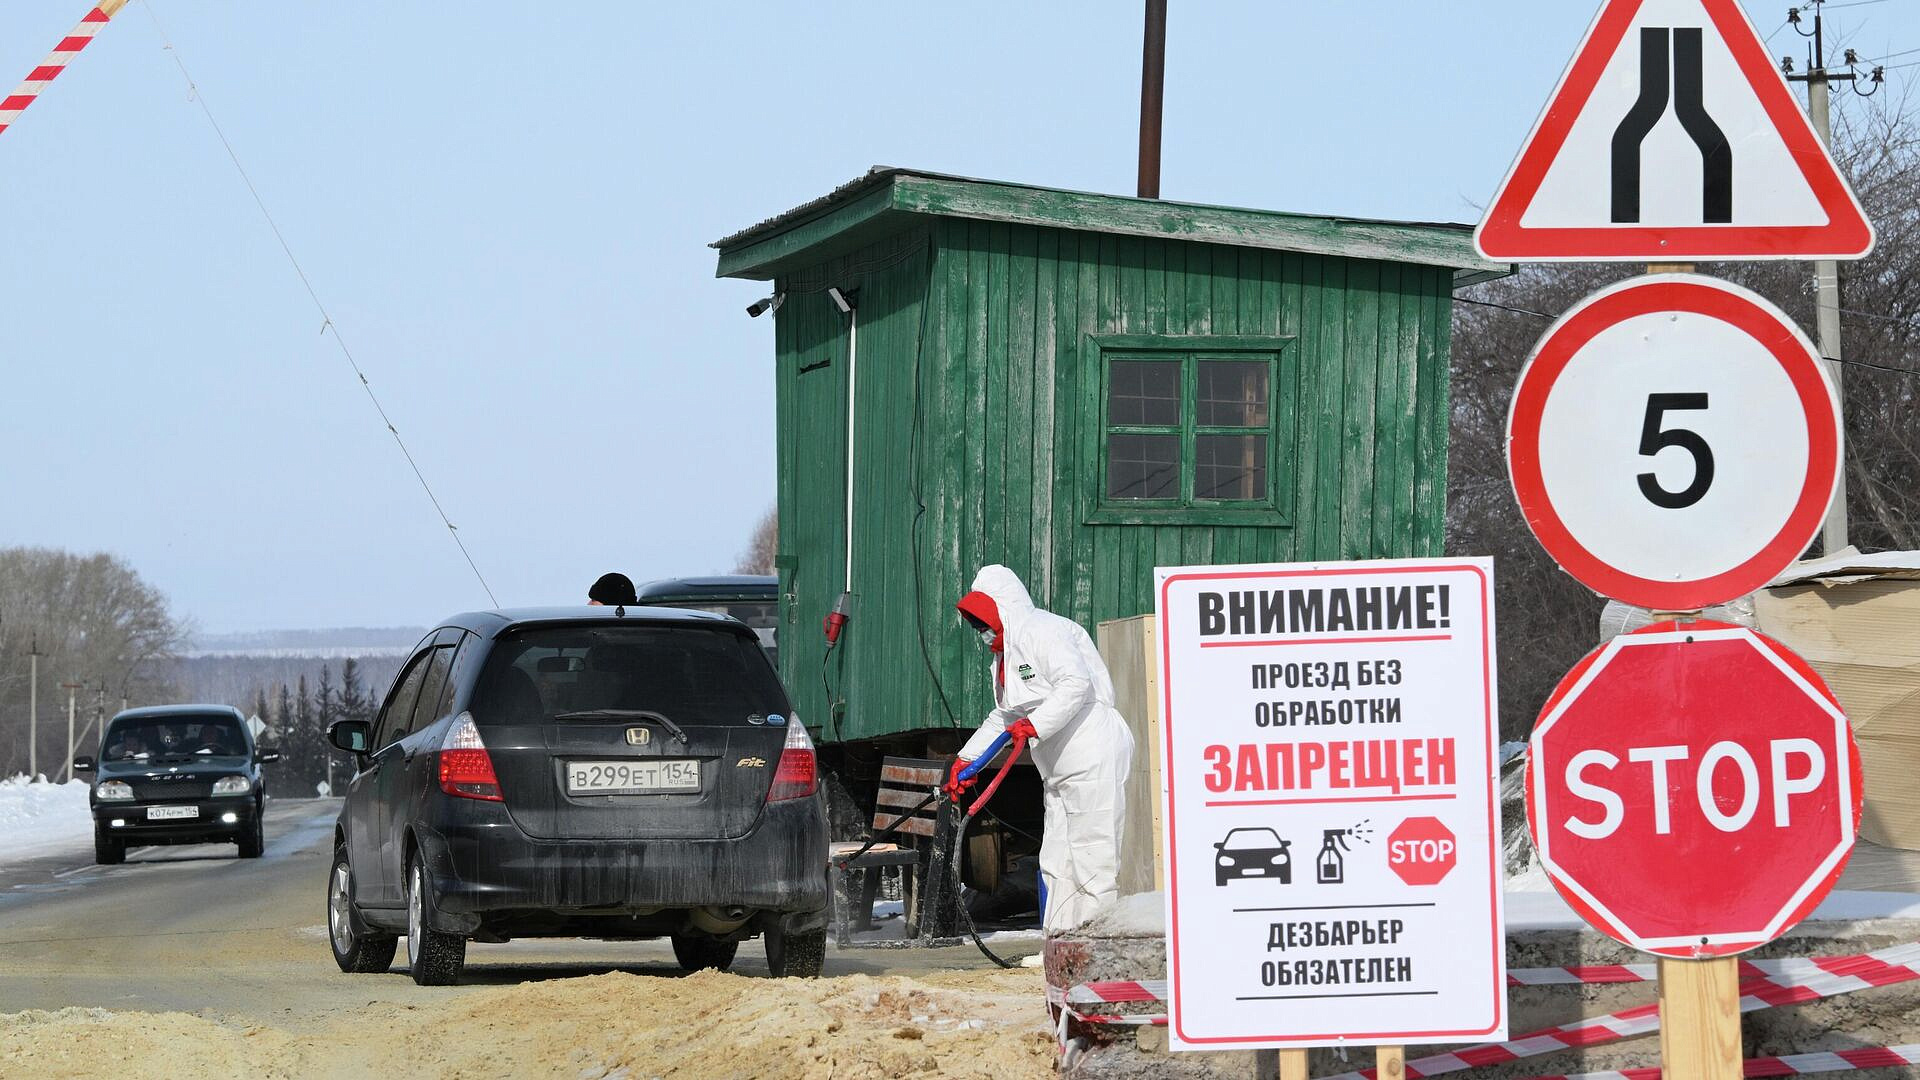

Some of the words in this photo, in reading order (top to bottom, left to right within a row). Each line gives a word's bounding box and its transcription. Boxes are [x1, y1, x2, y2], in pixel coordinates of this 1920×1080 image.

[1636, 392, 1715, 509] 5
[1198, 584, 1451, 636] ВНИМАНИЕ!
[1251, 661, 1350, 690] ПРОЕЗД
[1357, 659, 1402, 686] БЕЗ
[1255, 698, 1402, 728] ОБРАБОТКИ
[1203, 737, 1456, 794] ЗАПРЕЩЕН
[1563, 737, 1826, 839] STOP
[1390, 839, 1454, 864] STOP
[1267, 919, 1404, 952] ДЕЗБАРЬЕР
[1261, 957, 1412, 987] ОБЯЗАТЕЛЕН
